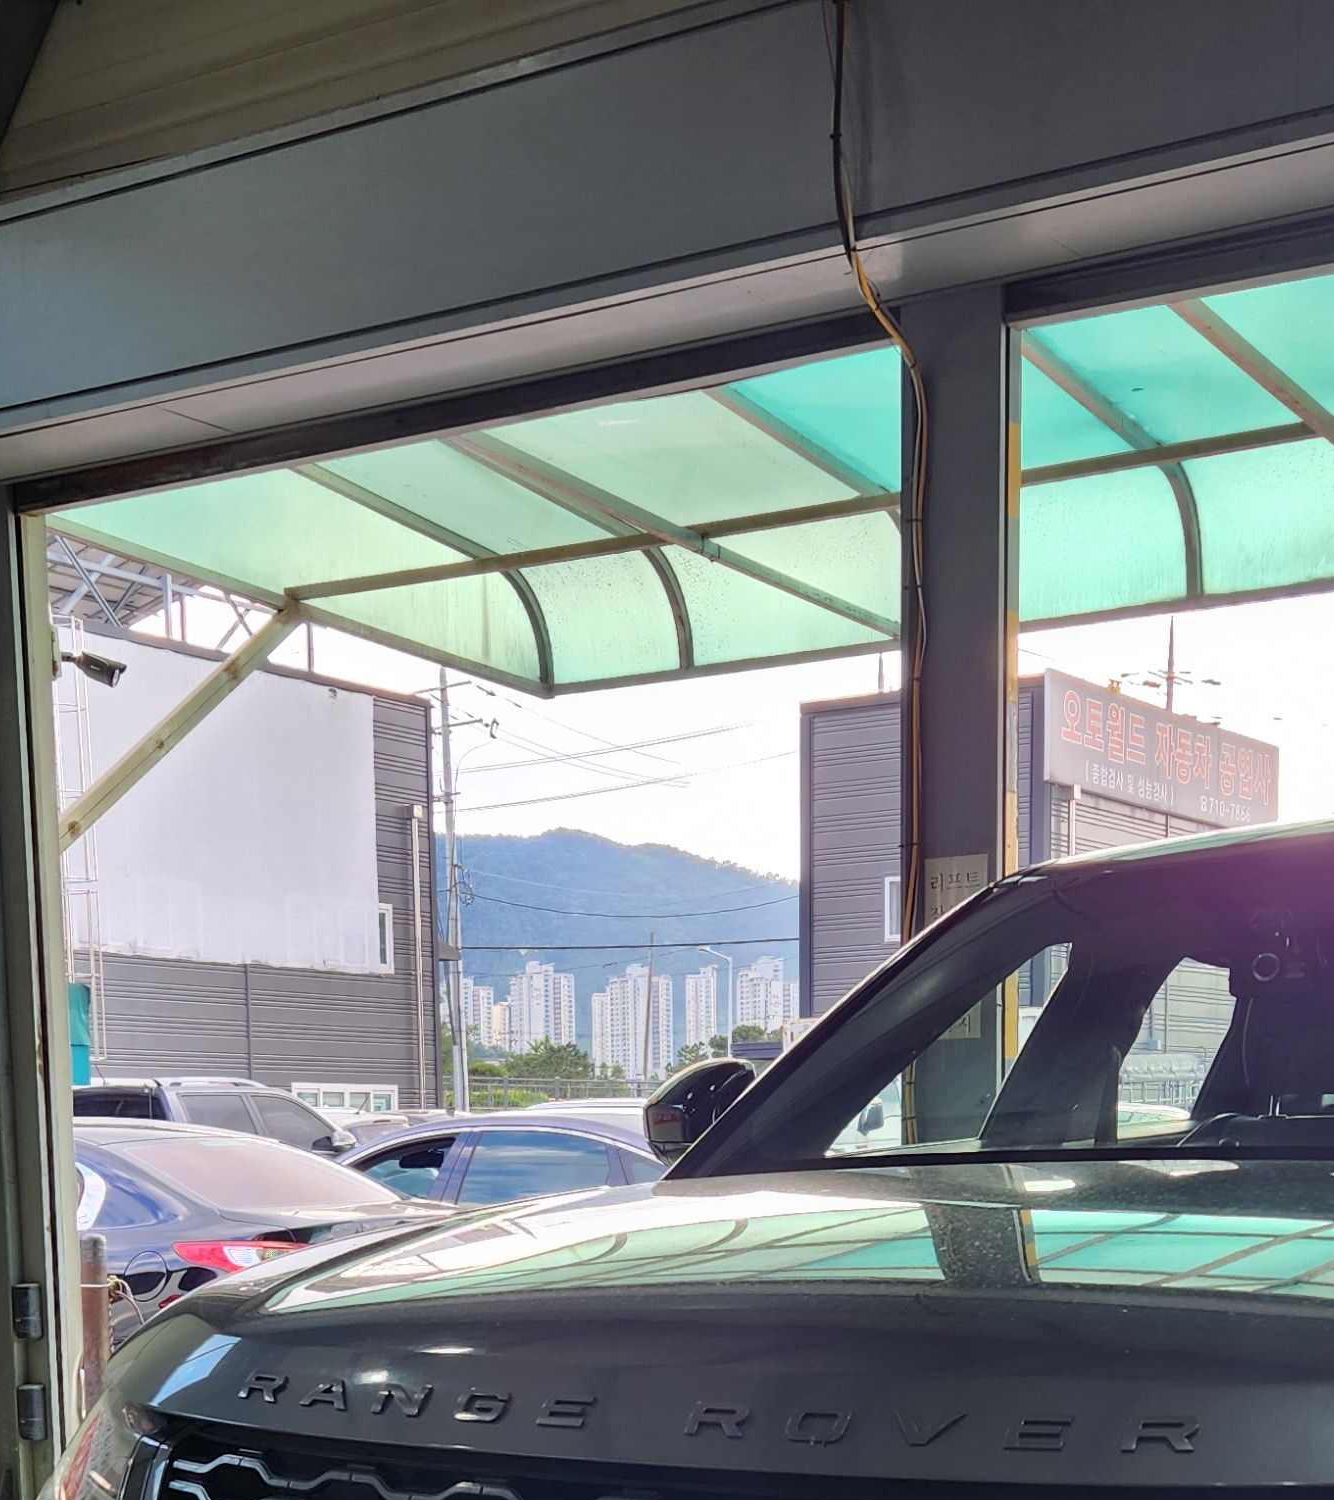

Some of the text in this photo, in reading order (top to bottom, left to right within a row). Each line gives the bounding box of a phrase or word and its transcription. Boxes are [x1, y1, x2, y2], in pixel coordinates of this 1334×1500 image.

[1061, 690, 1272, 806] 오토월드 자동차 공업사
[930, 871, 981, 892] 리프트
[237, 1371, 1201, 1453] RANGE ROVER
